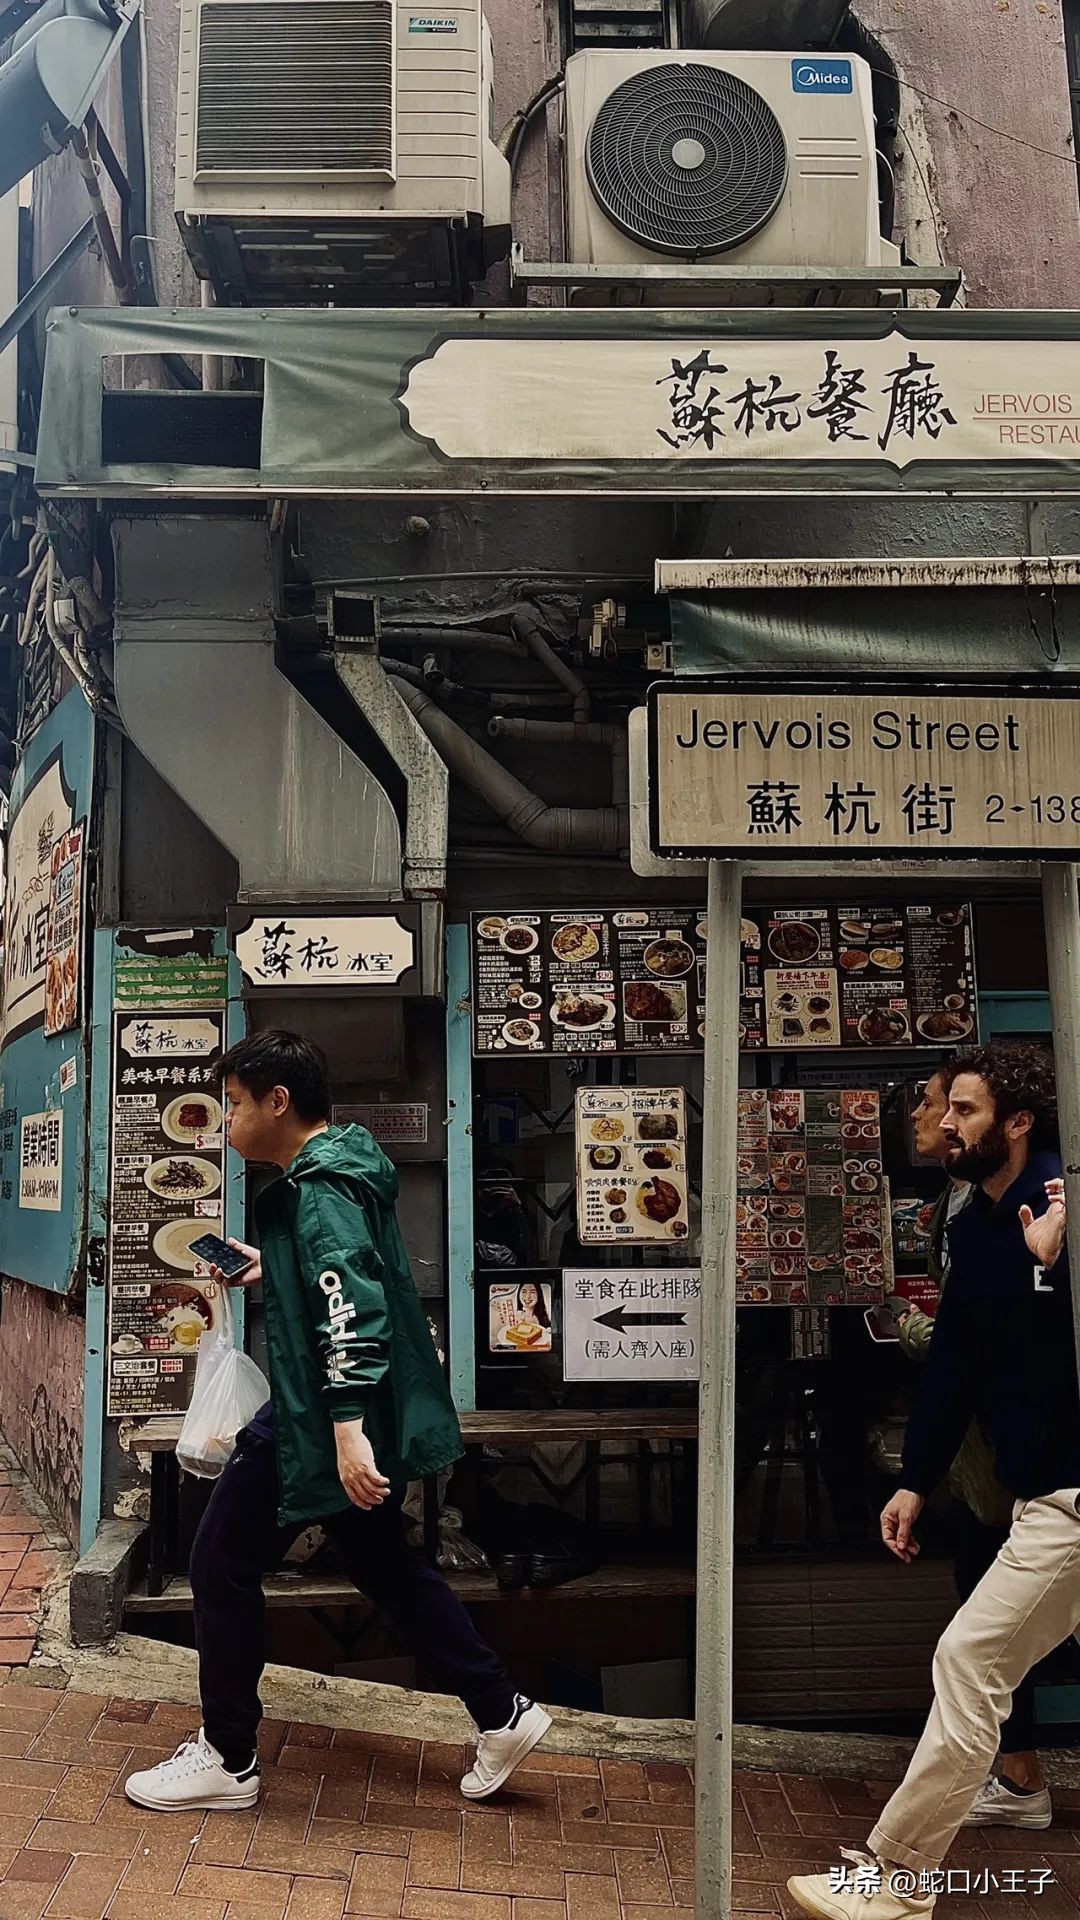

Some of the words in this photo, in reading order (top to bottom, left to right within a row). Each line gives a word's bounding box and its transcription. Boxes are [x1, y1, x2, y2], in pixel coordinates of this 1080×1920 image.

[801, 70, 848, 85] Midea
[656, 349, 958, 451] 蘇杭餐廳
[974, 394, 1072, 413] JERVOIS
[677, 709, 852, 750] Jervois
[873, 710, 1020, 752] Street
[746, 780, 956, 835] 蘇杭街
[131, 1021, 208, 1054] 蘇杭冰室
[22, 1120, 59, 1168] 營業時間
[574, 1278, 701, 1300] 堂食在此排隊
[585, 1339, 695, 1359] (需人齊入座)
[115, 1361, 156, 1370] 三文治套餐
